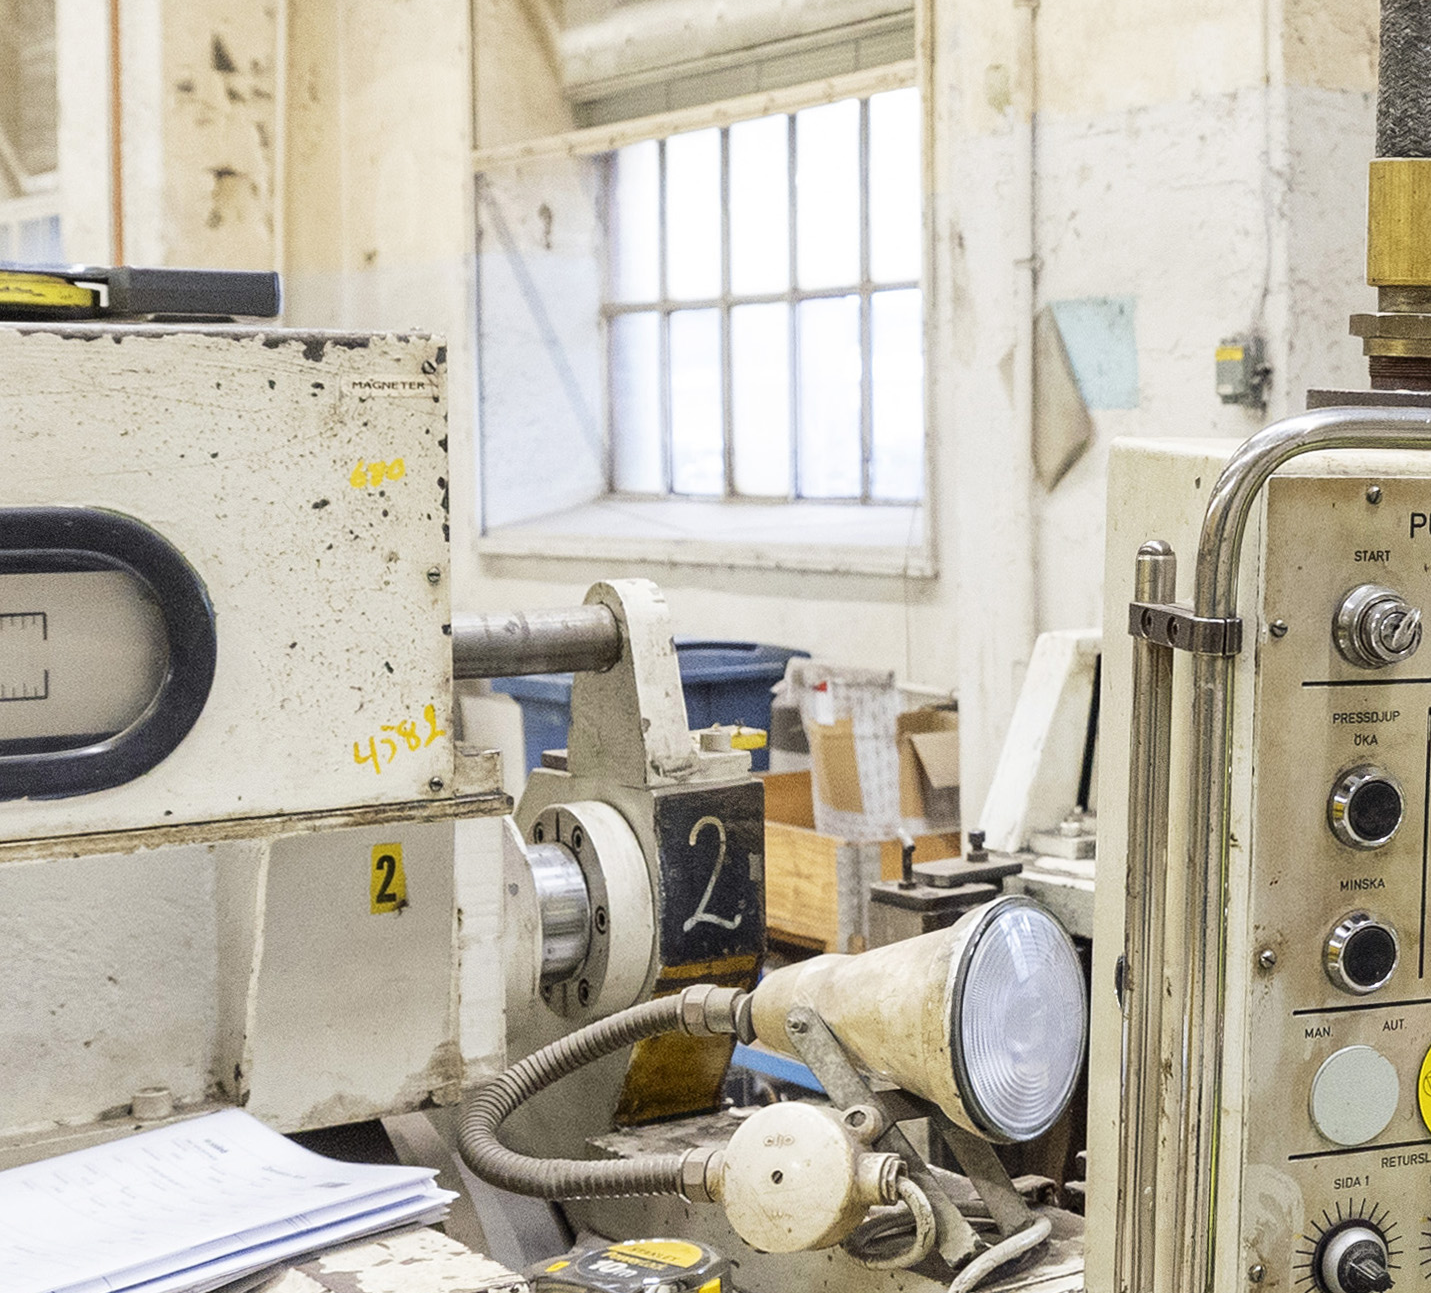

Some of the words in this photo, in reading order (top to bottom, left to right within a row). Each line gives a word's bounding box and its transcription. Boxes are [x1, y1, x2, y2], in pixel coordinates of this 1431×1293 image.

[352, 381, 425, 390] MAGNETER
[1354, 551, 1391, 562] START
[1332, 710, 1401, 725] PRESSDJUP
[1353, 733, 1378, 746] ÖKA
[375, 854, 396, 904] 2
[683, 815, 742, 932] 2
[1340, 878, 1386, 892] MINSKA
[1304, 1025, 1334, 1040] MAN.
[1382, 1018, 1408, 1033] AUT.
[1333, 1177, 1361, 1191] SIDA
